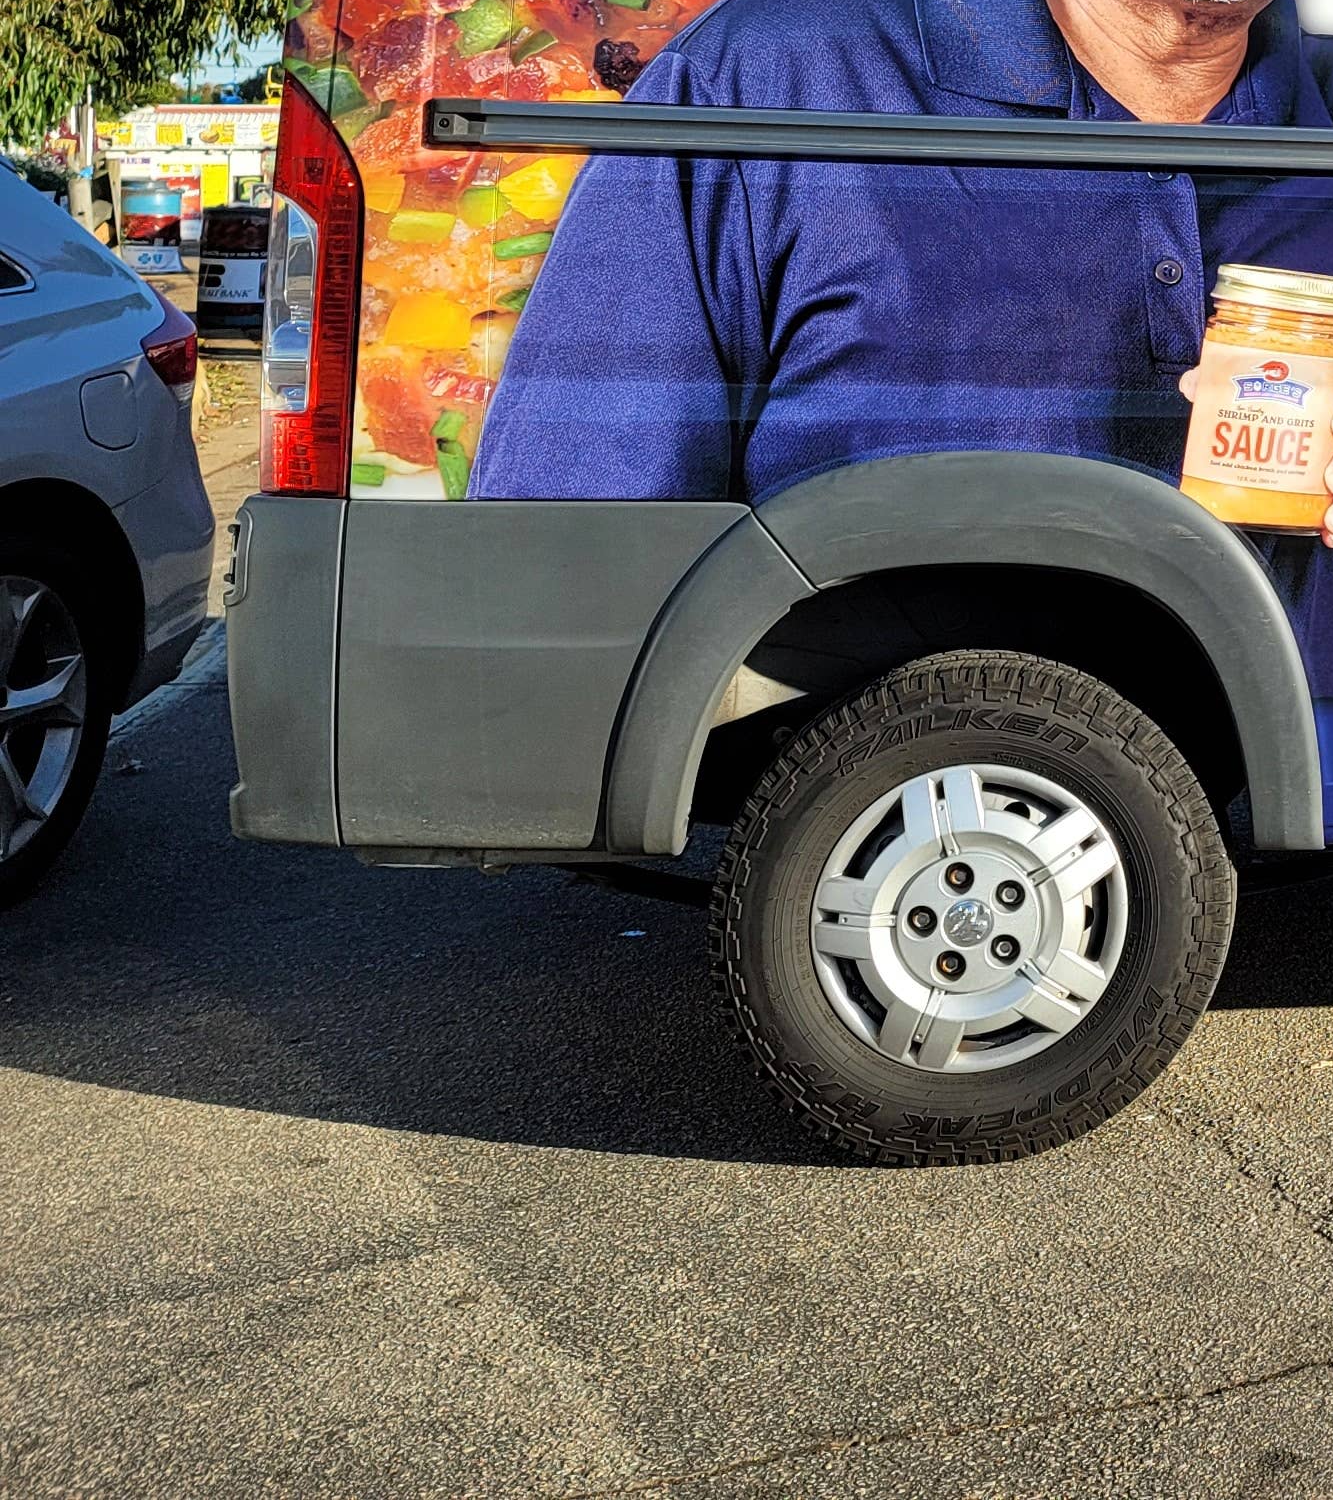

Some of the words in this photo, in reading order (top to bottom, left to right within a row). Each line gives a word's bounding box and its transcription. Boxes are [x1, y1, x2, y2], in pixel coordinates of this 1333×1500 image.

[1211, 421, 1313, 467] SAUCE
[1217, 408, 1259, 422] SHRIMP
[1261, 416, 1284, 425] AND
[1287, 418, 1315, 428] GRITS
[829, 707, 1089, 777] FALKEN
[888, 985, 1165, 1137] WILDPEAK
